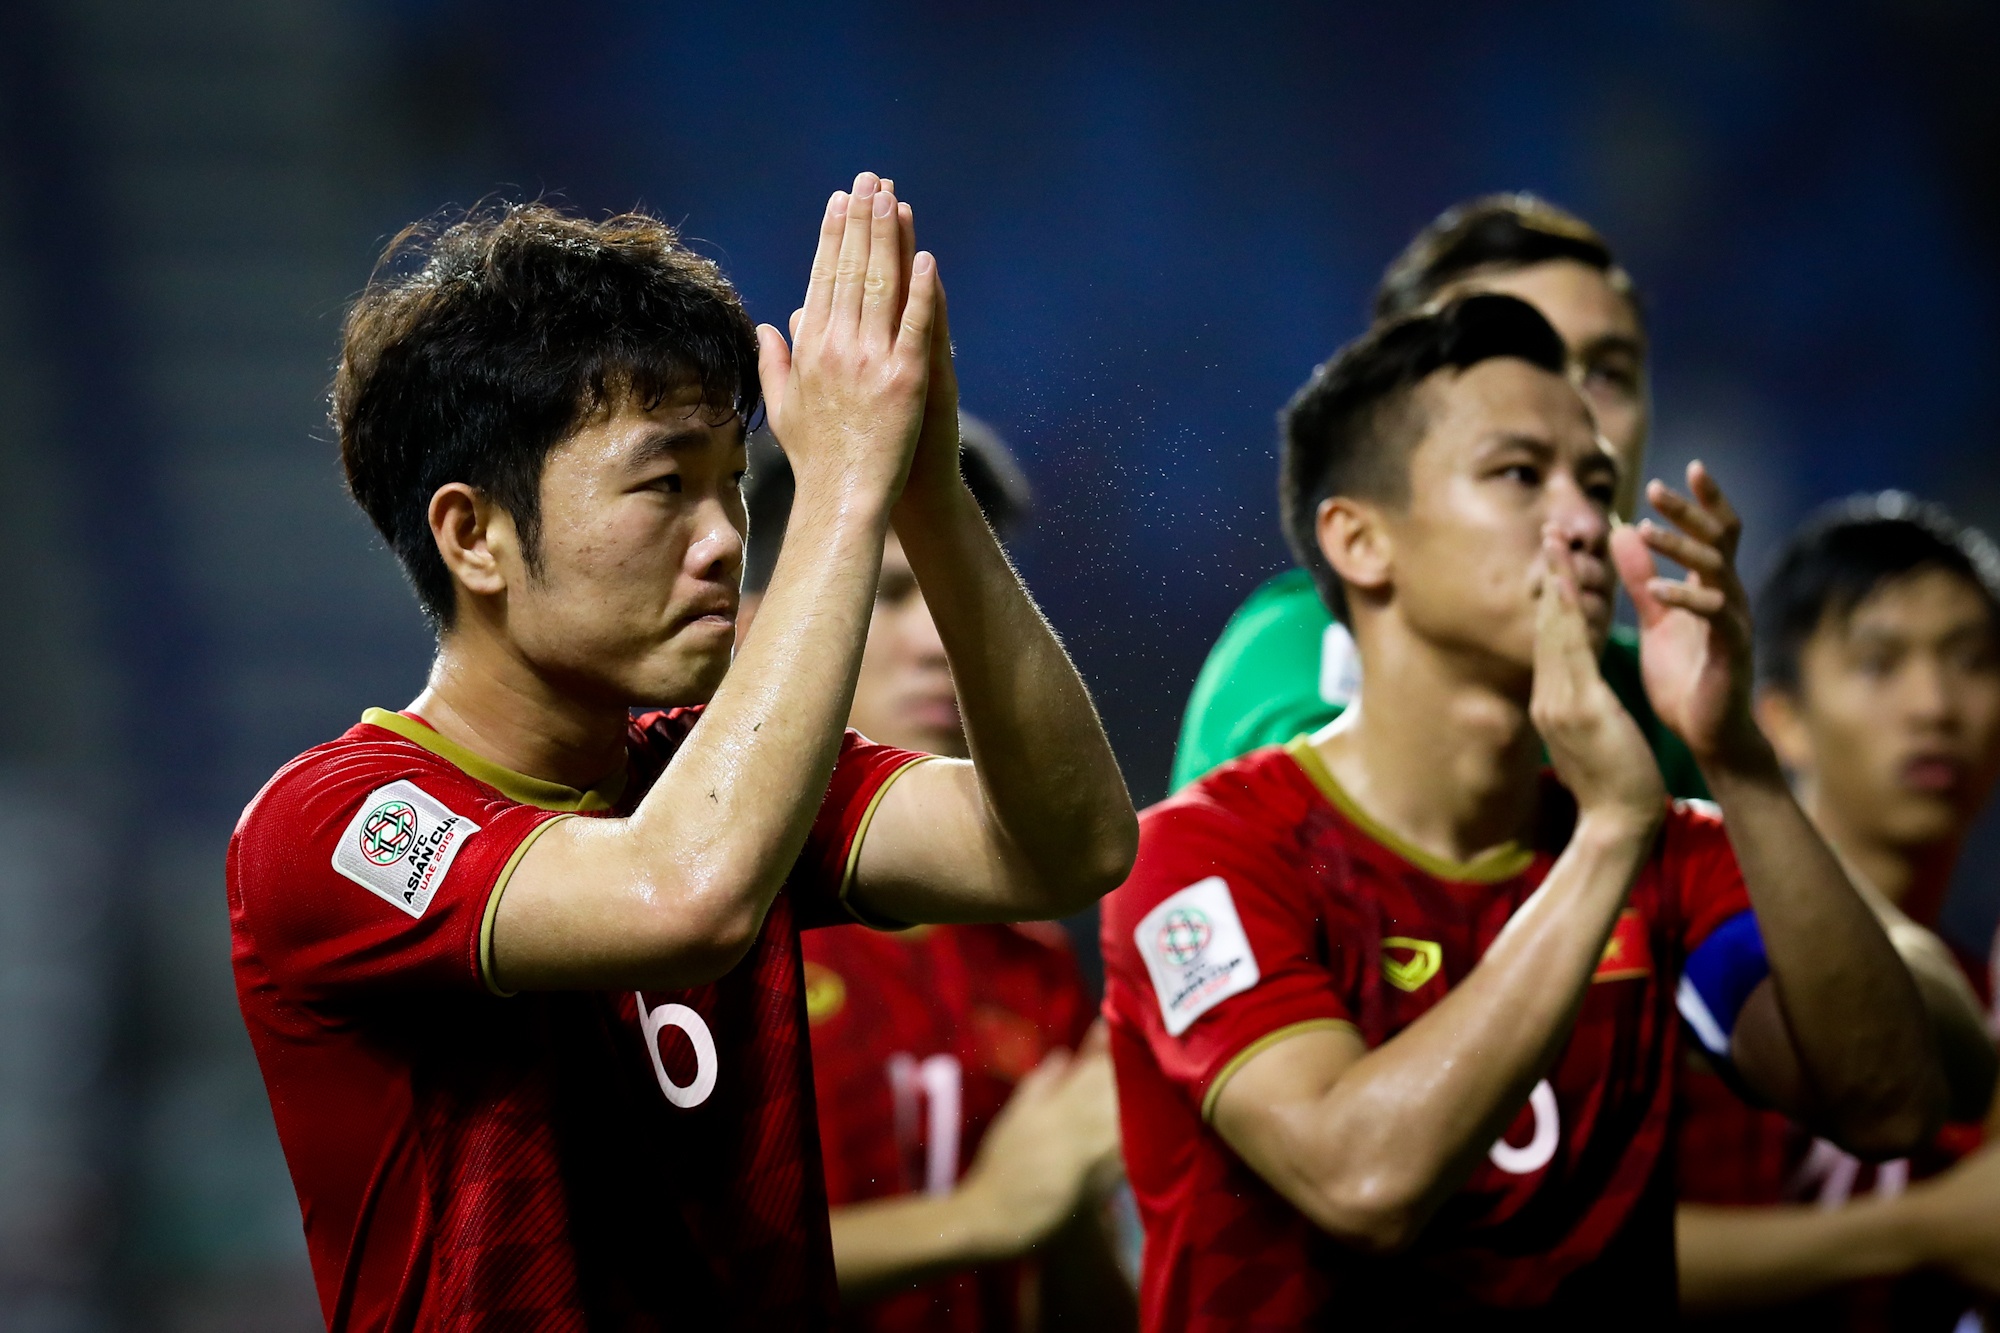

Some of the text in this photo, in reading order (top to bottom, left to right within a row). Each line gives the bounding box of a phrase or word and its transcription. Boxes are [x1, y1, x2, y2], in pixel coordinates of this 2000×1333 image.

[403, 846, 435, 904] ASIAN
[408, 834, 428, 866] AFC
[420, 831, 454, 890] UAE 2019
[634, 990, 718, 1108] 6
